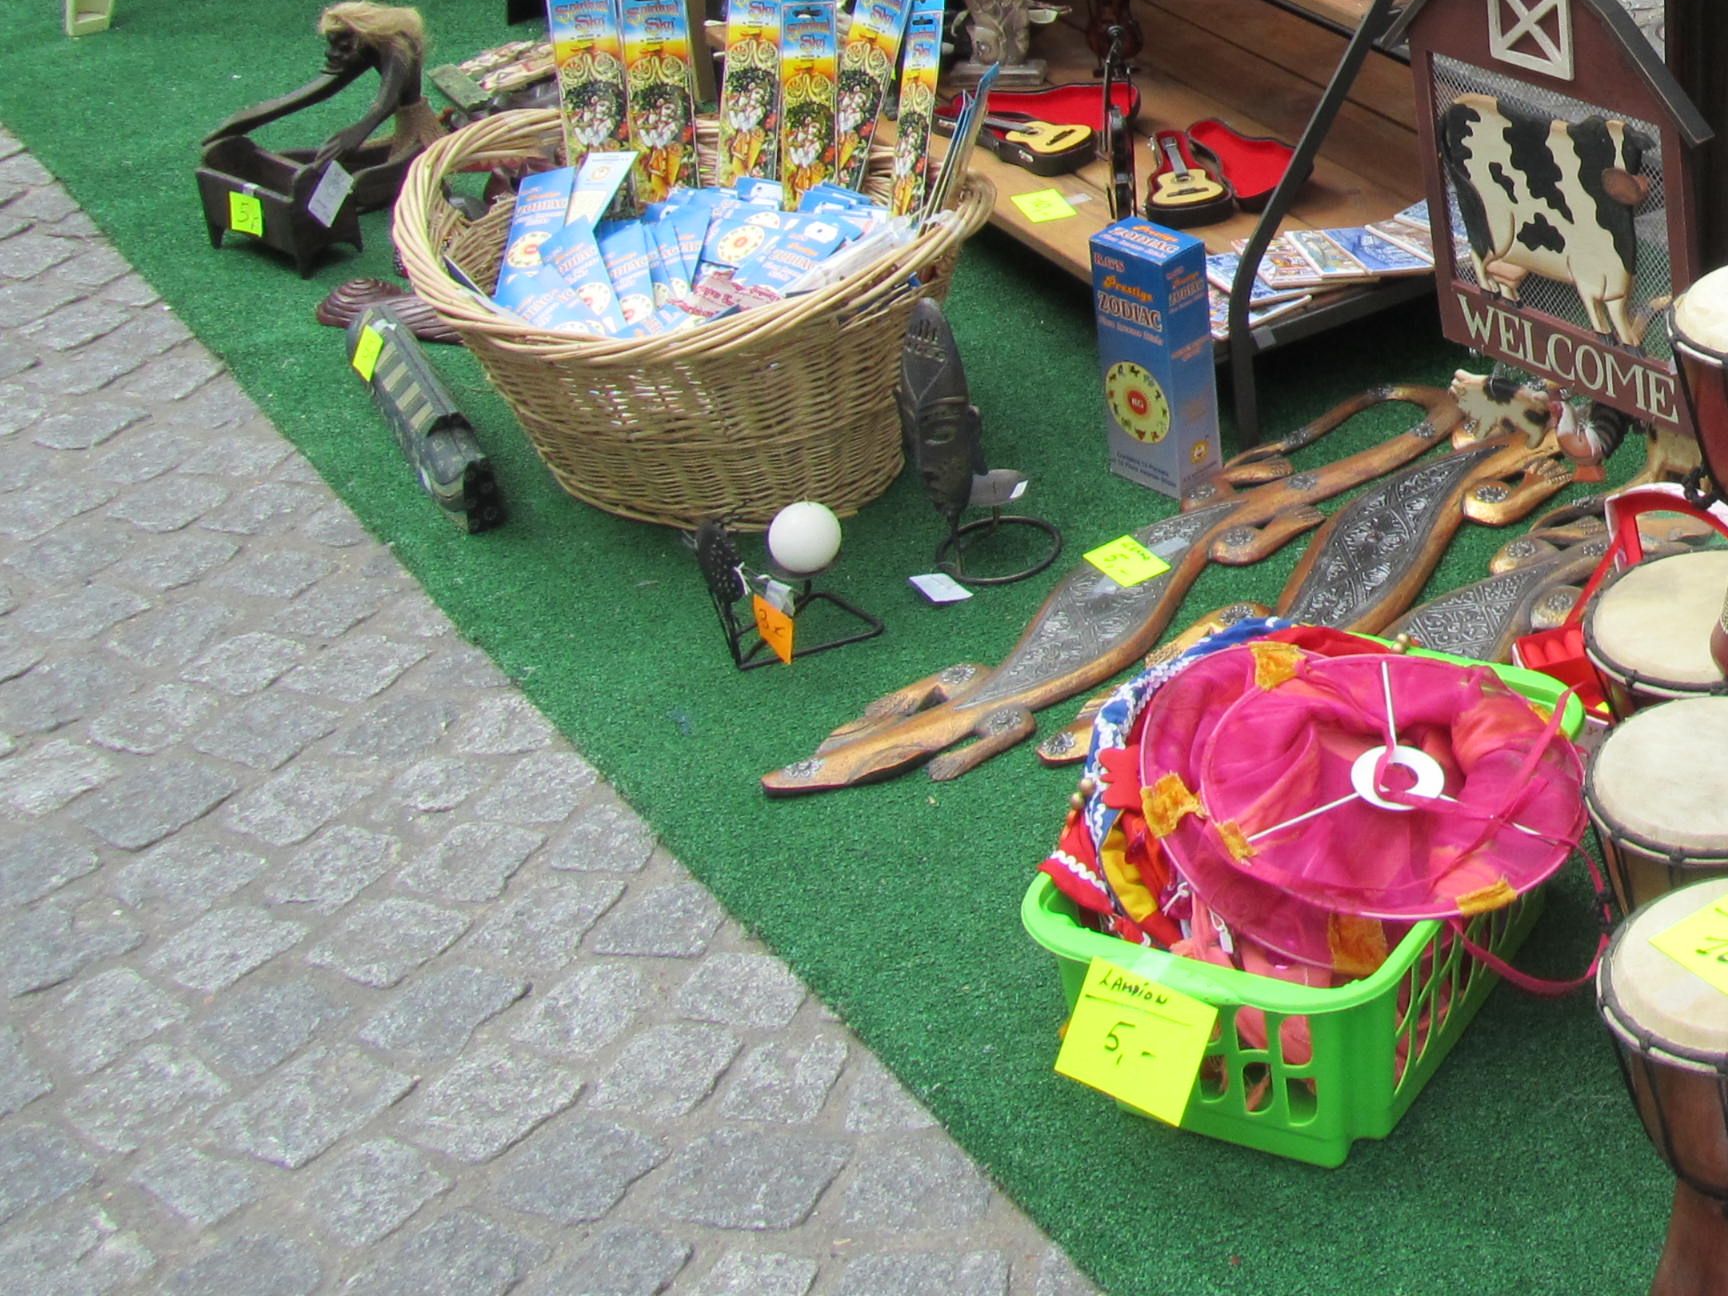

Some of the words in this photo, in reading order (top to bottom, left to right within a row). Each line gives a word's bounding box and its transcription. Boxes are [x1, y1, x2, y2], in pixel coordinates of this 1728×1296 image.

[1109, 226, 1180, 254] ZODIAC
[1097, 289, 1163, 334] ZODIAC
[1456, 293, 1680, 425] WELCOME
